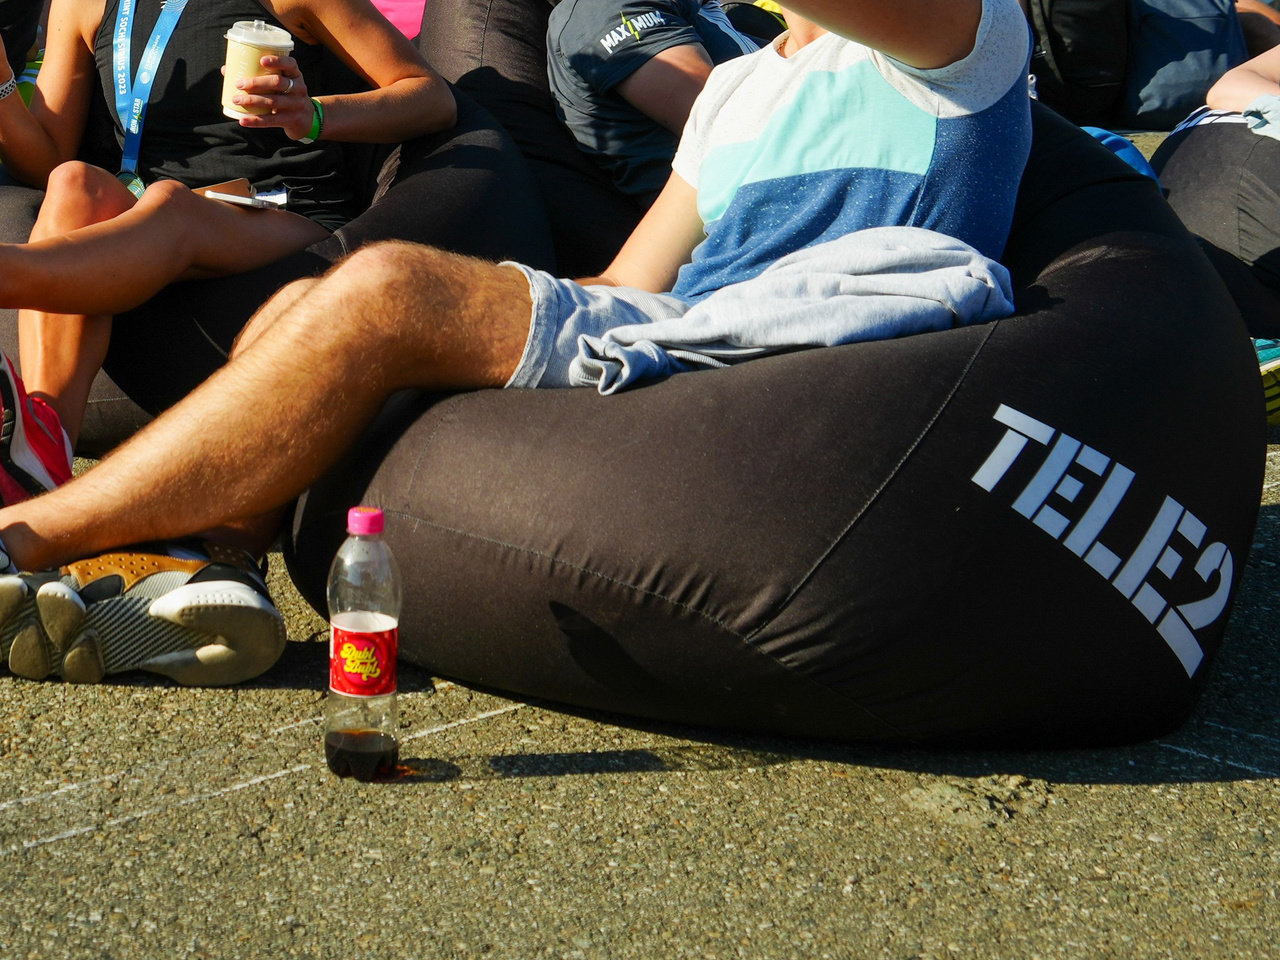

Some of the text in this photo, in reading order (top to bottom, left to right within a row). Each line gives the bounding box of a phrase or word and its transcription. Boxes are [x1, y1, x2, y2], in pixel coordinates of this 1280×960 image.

[118, 16, 129, 40] SOCHI
[117, 42, 126, 71] SIRIUS
[117, 72, 127, 95] 2023
[971, 403, 1234, 679] TELE2
[341, 643, 376, 662] Dubl
[344, 659, 381, 681] Bubl
